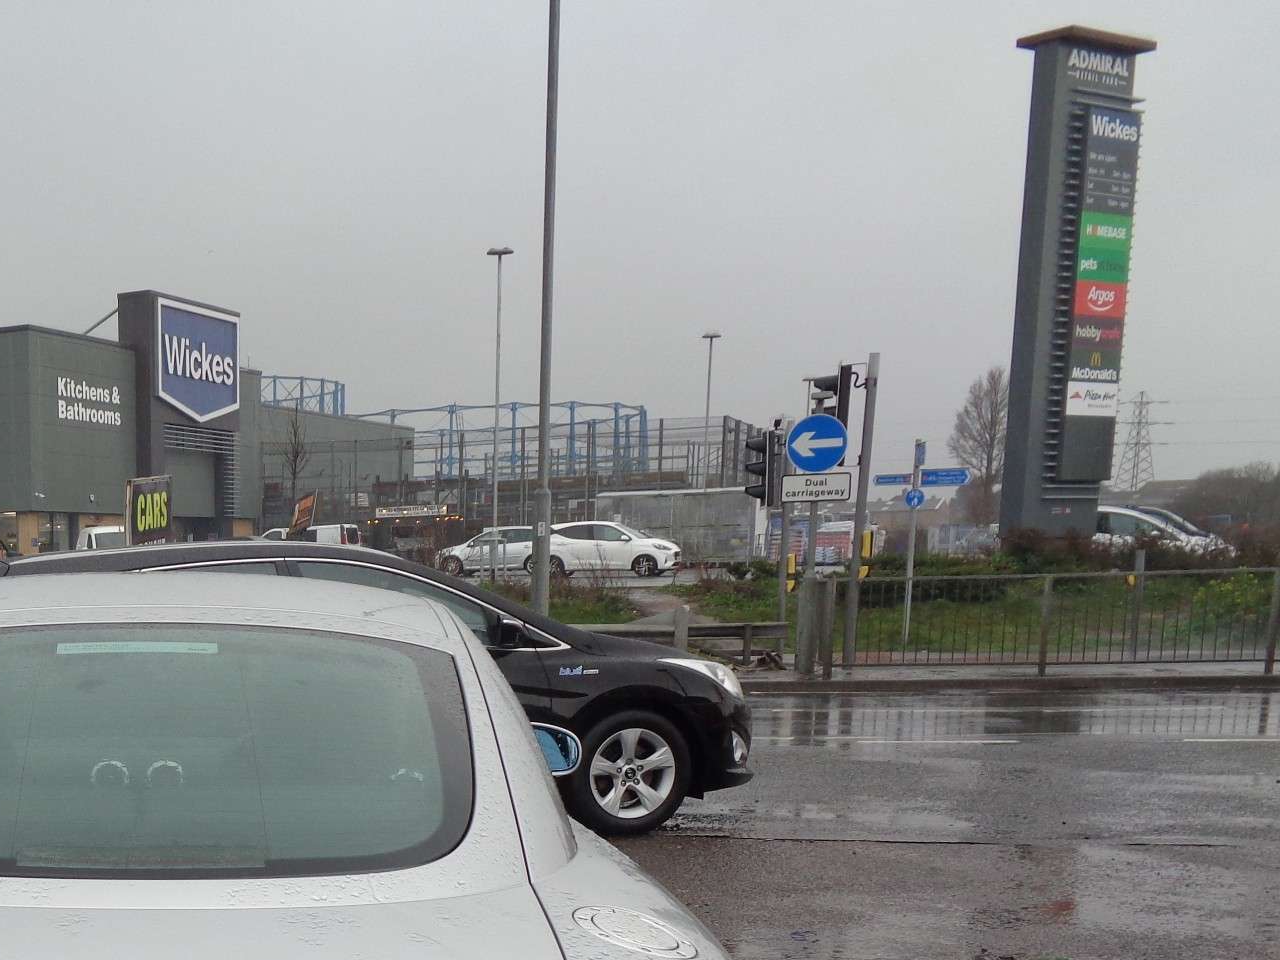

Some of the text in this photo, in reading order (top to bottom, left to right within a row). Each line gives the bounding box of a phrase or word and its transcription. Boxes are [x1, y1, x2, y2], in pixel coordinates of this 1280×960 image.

[1068, 48, 1129, 76] ADMIRAL
[1092, 114, 1138, 141] Wickes
[1088, 286, 1115, 304] Argos
[164, 333, 234, 386] Wickes
[57, 376, 121, 404] Kitchens &
[58, 400, 121, 426] Bathrooms
[785, 488, 846, 497] carriageway
[805, 478, 828, 486] Dual
[137, 491, 168, 531] CARS
